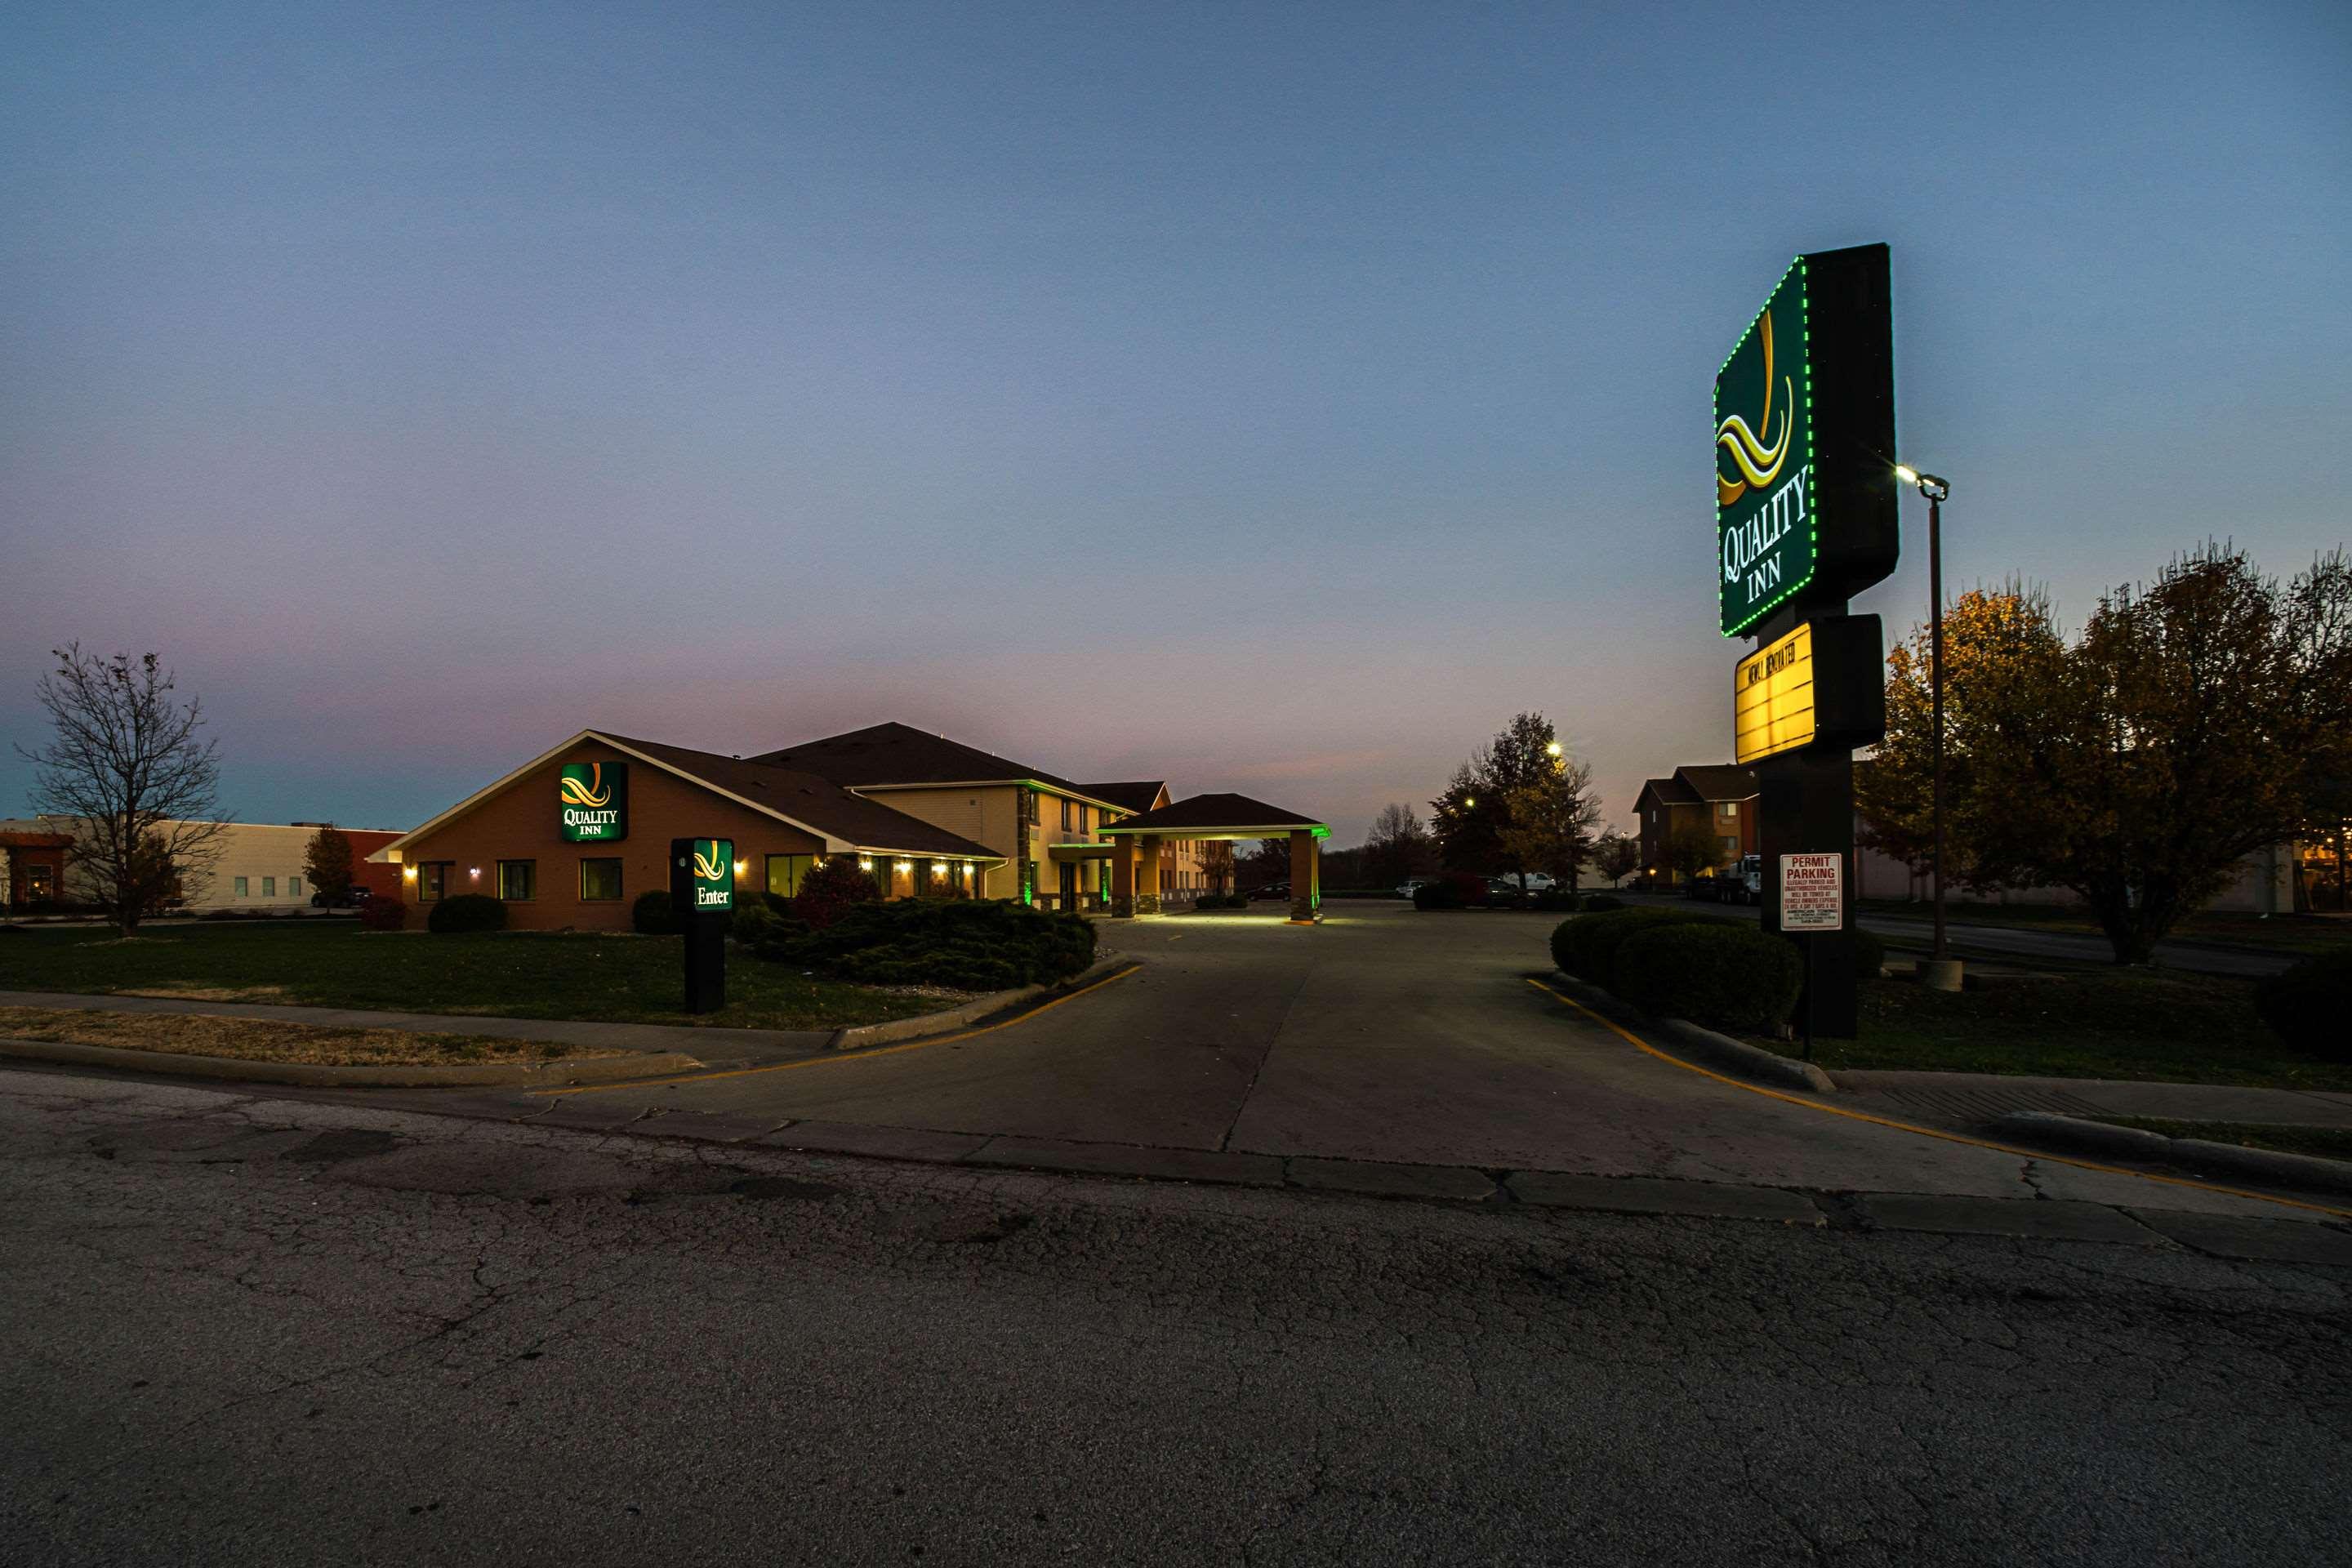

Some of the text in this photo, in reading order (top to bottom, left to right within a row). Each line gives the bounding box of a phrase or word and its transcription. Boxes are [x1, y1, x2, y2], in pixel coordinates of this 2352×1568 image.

[1724, 465, 1808, 583] QUALITY
[1747, 551, 1781, 604] INN
[564, 808, 617, 826] QUALITY
[579, 826, 601, 835] INN
[1792, 857, 1830, 867] PERMIT
[1787, 868, 1835, 879] PARKING
[697, 887, 729, 905] Enter
